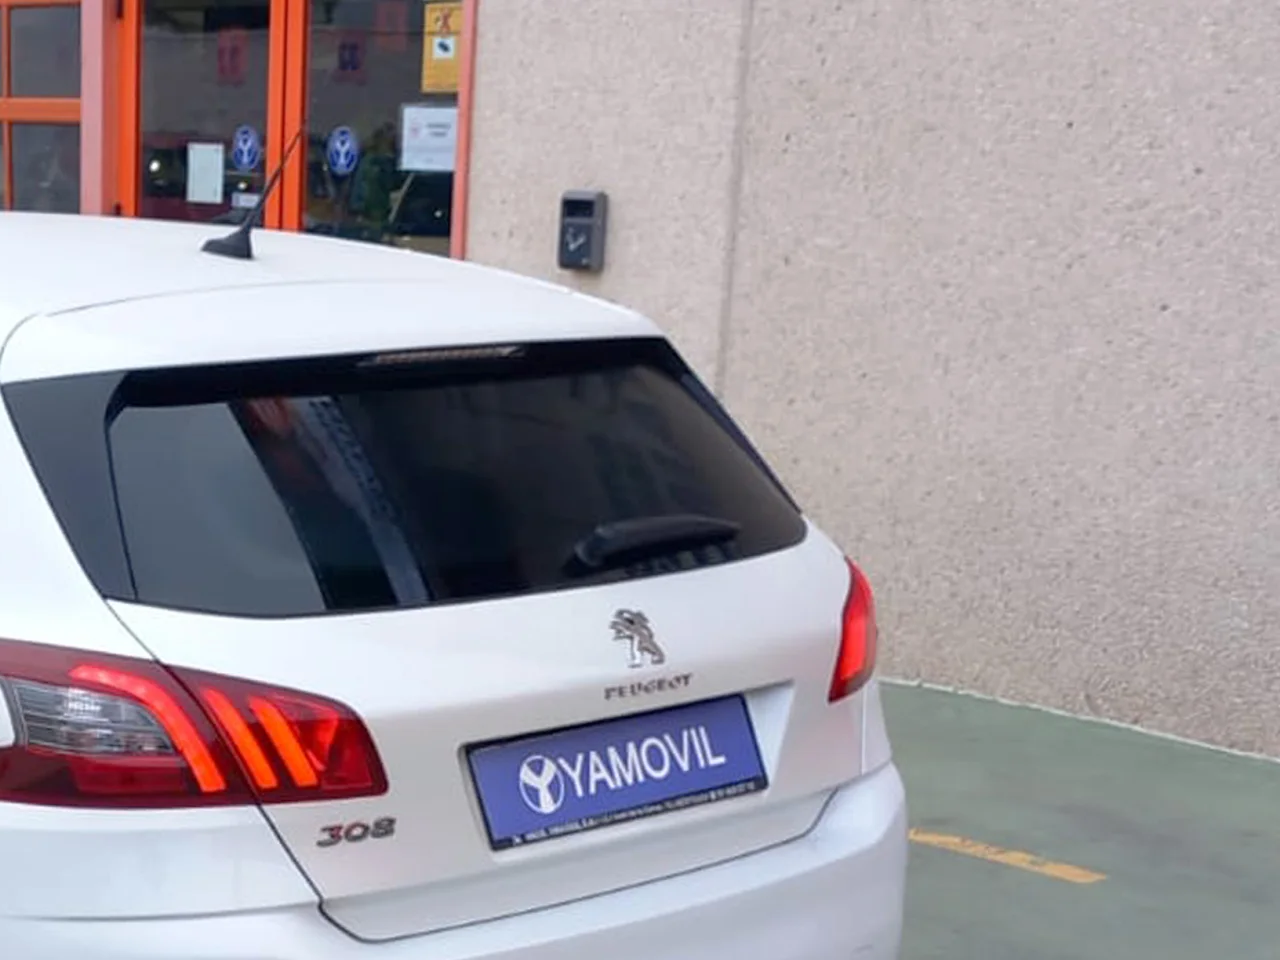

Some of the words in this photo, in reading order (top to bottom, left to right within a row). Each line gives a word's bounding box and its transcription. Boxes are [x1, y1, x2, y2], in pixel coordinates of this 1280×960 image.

[604, 673, 693, 701] PEUGEOT
[558, 726, 727, 798] YAMOVIL
[316, 817, 397, 847] 308
